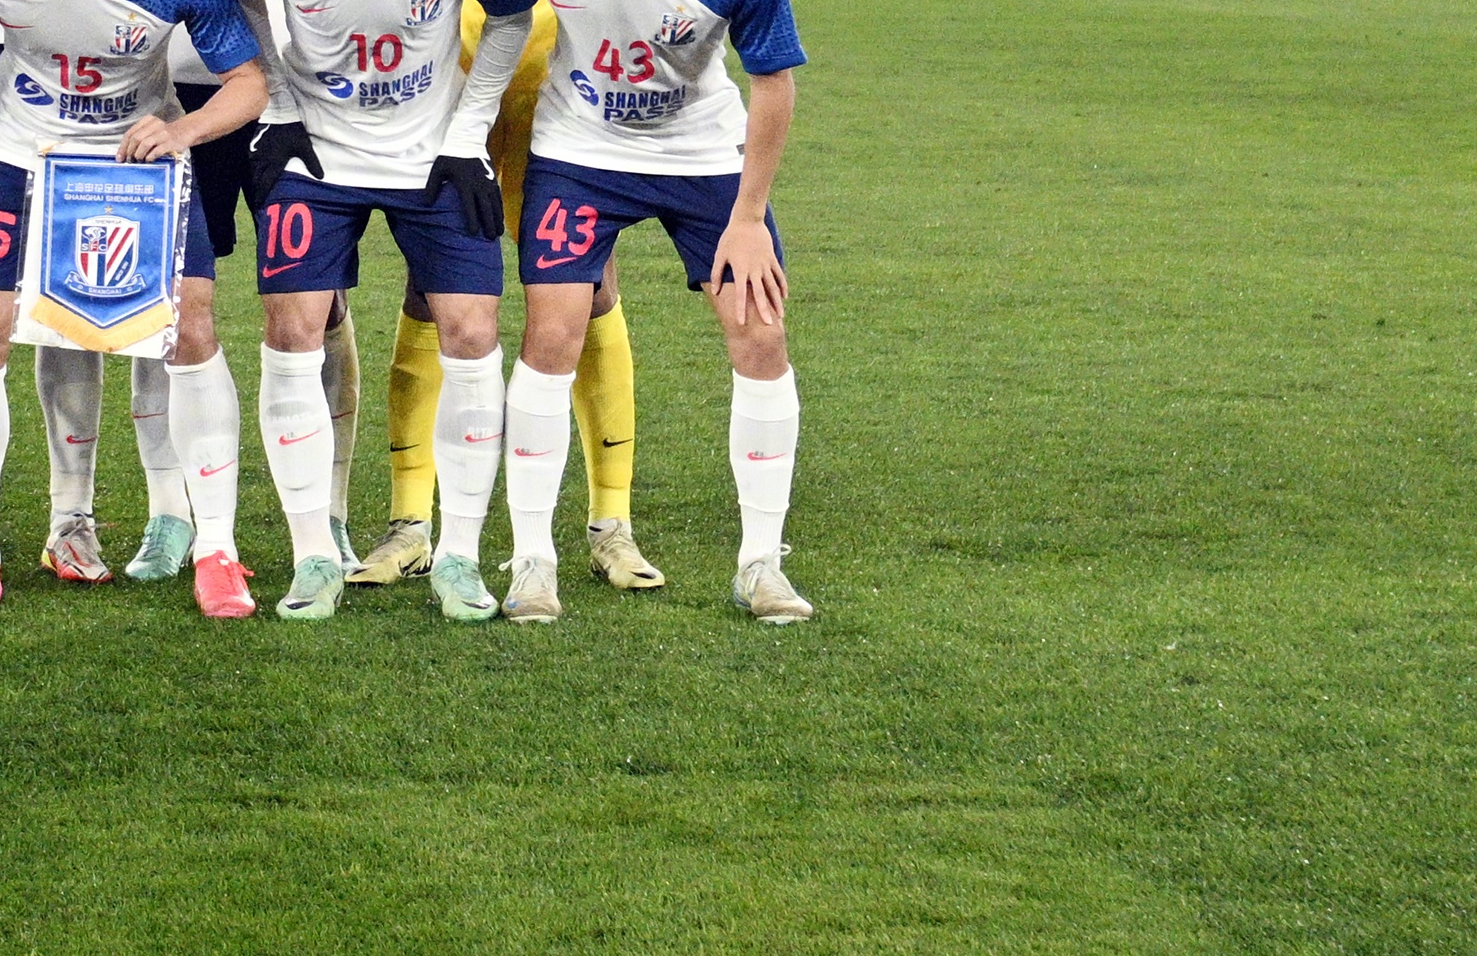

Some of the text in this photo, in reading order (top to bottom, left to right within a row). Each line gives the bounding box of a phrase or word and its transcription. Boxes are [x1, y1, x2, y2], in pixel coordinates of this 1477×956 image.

[349, 33, 403, 73] 10
[592, 39, 656, 84] 43
[51, 53, 103, 93] 15
[358, 60, 434, 97] SHANGHAI
[358, 76, 433, 108] PASS
[58, 102, 138, 125] PASS
[604, 85, 686, 109] SHANGHAI
[604, 100, 685, 122] PASS
[266, 202, 314, 259] 10
[536, 198, 599, 257] 43
